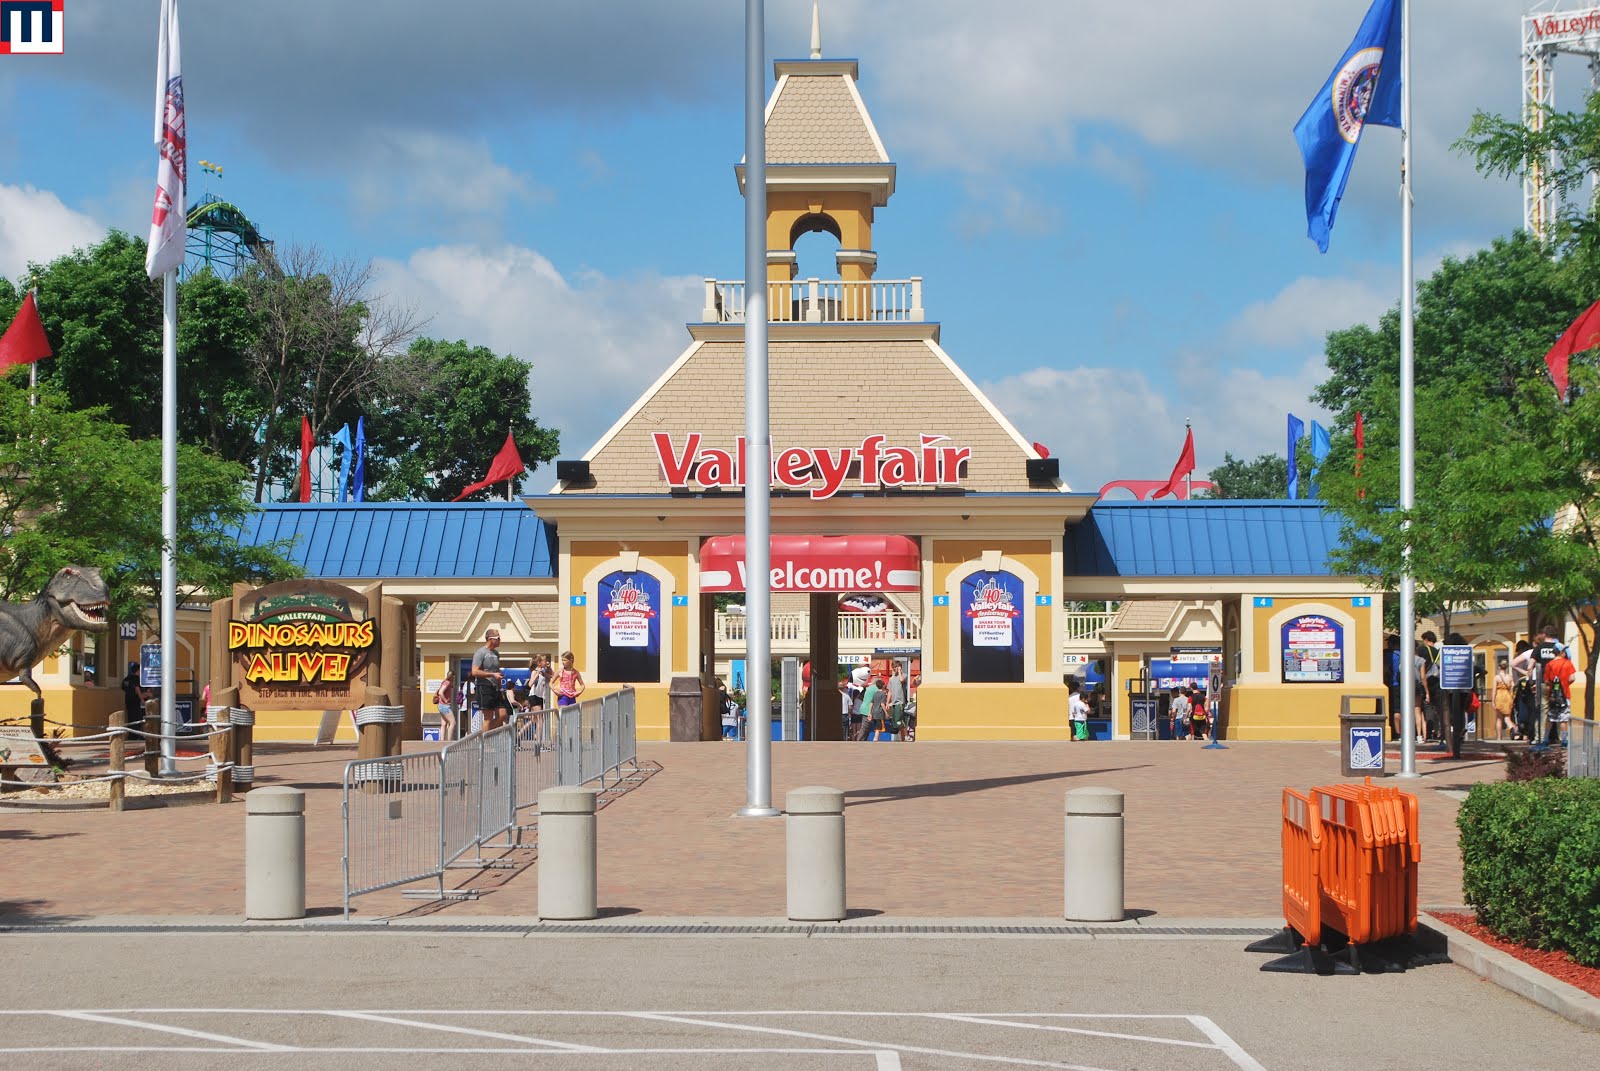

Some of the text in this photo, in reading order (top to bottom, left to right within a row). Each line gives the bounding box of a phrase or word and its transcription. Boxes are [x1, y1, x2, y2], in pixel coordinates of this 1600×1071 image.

[1338, 79, 1351, 132] MINNESOTA
[650, 432, 972, 500] Valeyfair
[621, 589, 638, 604] 40
[984, 589, 1000, 603] 40
[607, 602, 651, 612] Valleyfair
[970, 602, 1014, 612] Valleyfair
[277, 612, 327, 622] VALLEYFAIR
[228, 620, 375, 649] DINOSAURS
[245, 651, 351, 683] ALIVE!
[259, 689, 272, 698] STEP
[1353, 730, 1381, 738] Valleyfair
